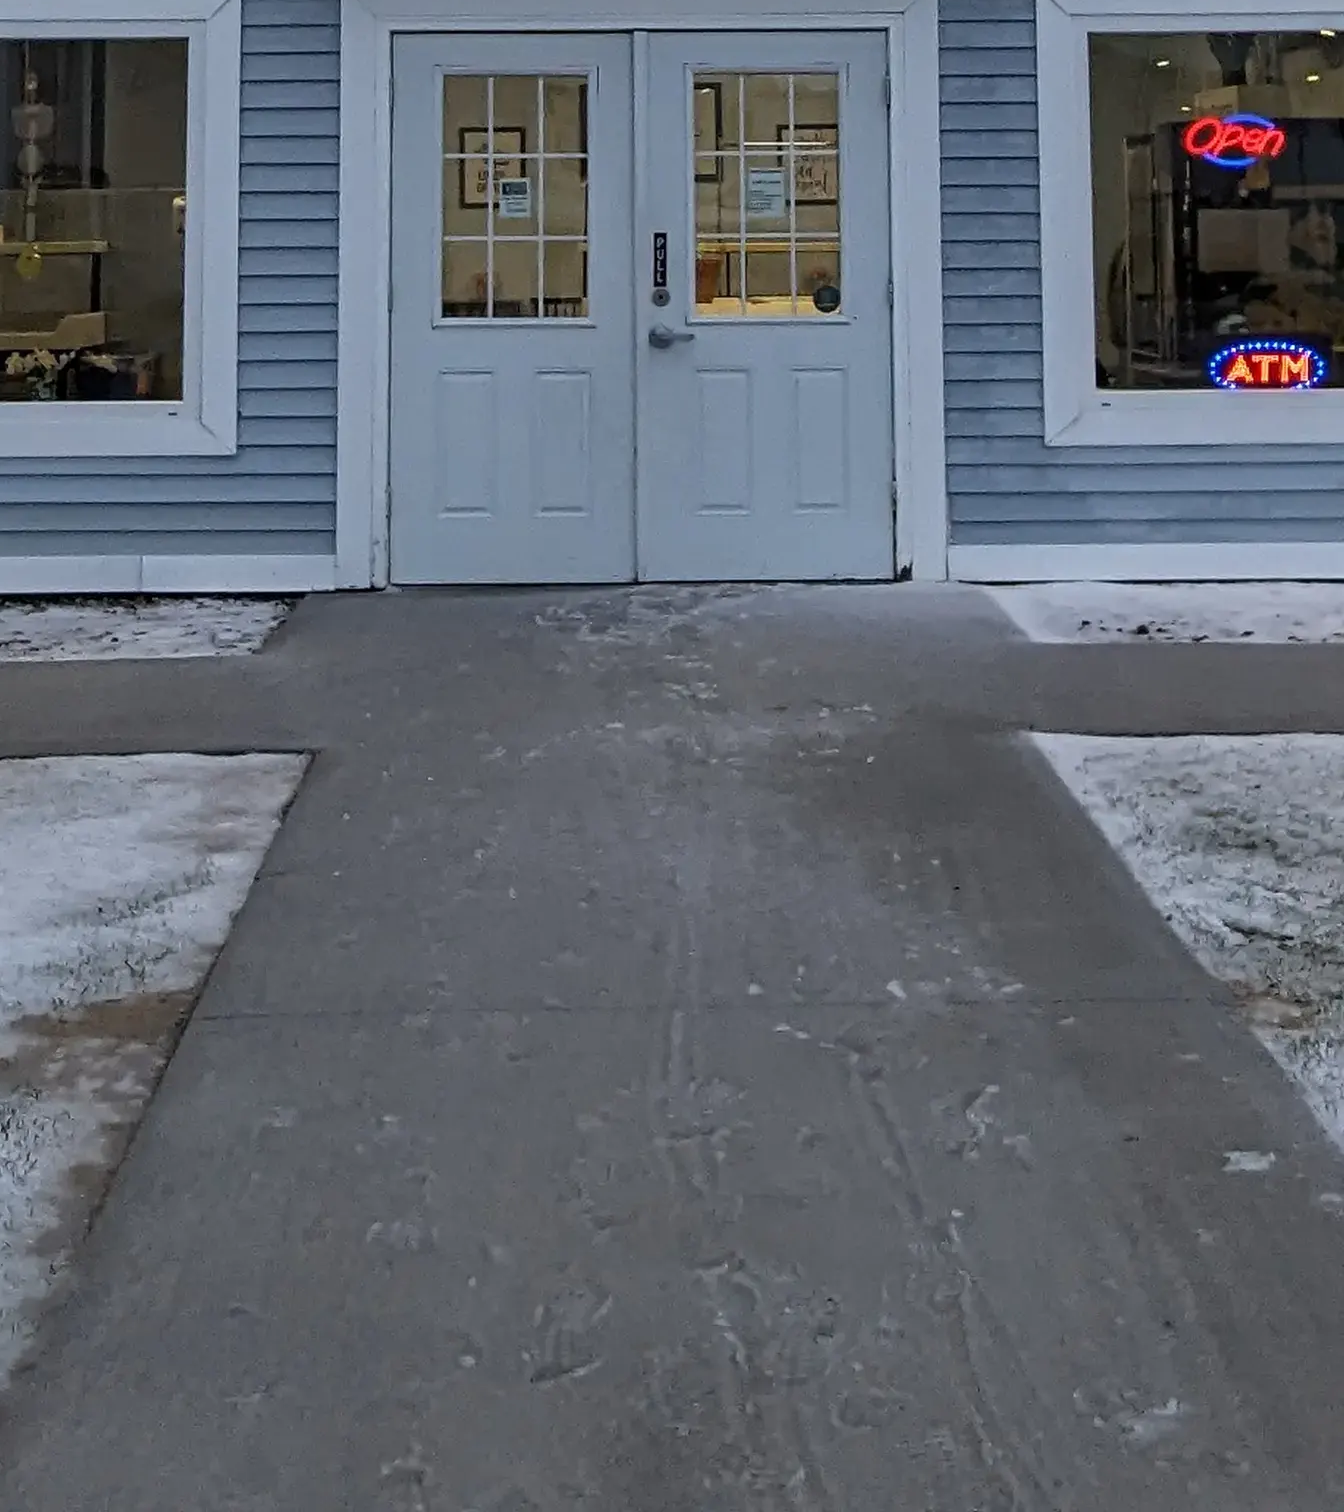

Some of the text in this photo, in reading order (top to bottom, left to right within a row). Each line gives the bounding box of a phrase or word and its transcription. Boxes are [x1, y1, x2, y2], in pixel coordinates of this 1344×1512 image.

[1183, 115, 1286, 158] Open
[655, 236, 666, 283] PULL
[1225, 354, 1310, 384] ATM
